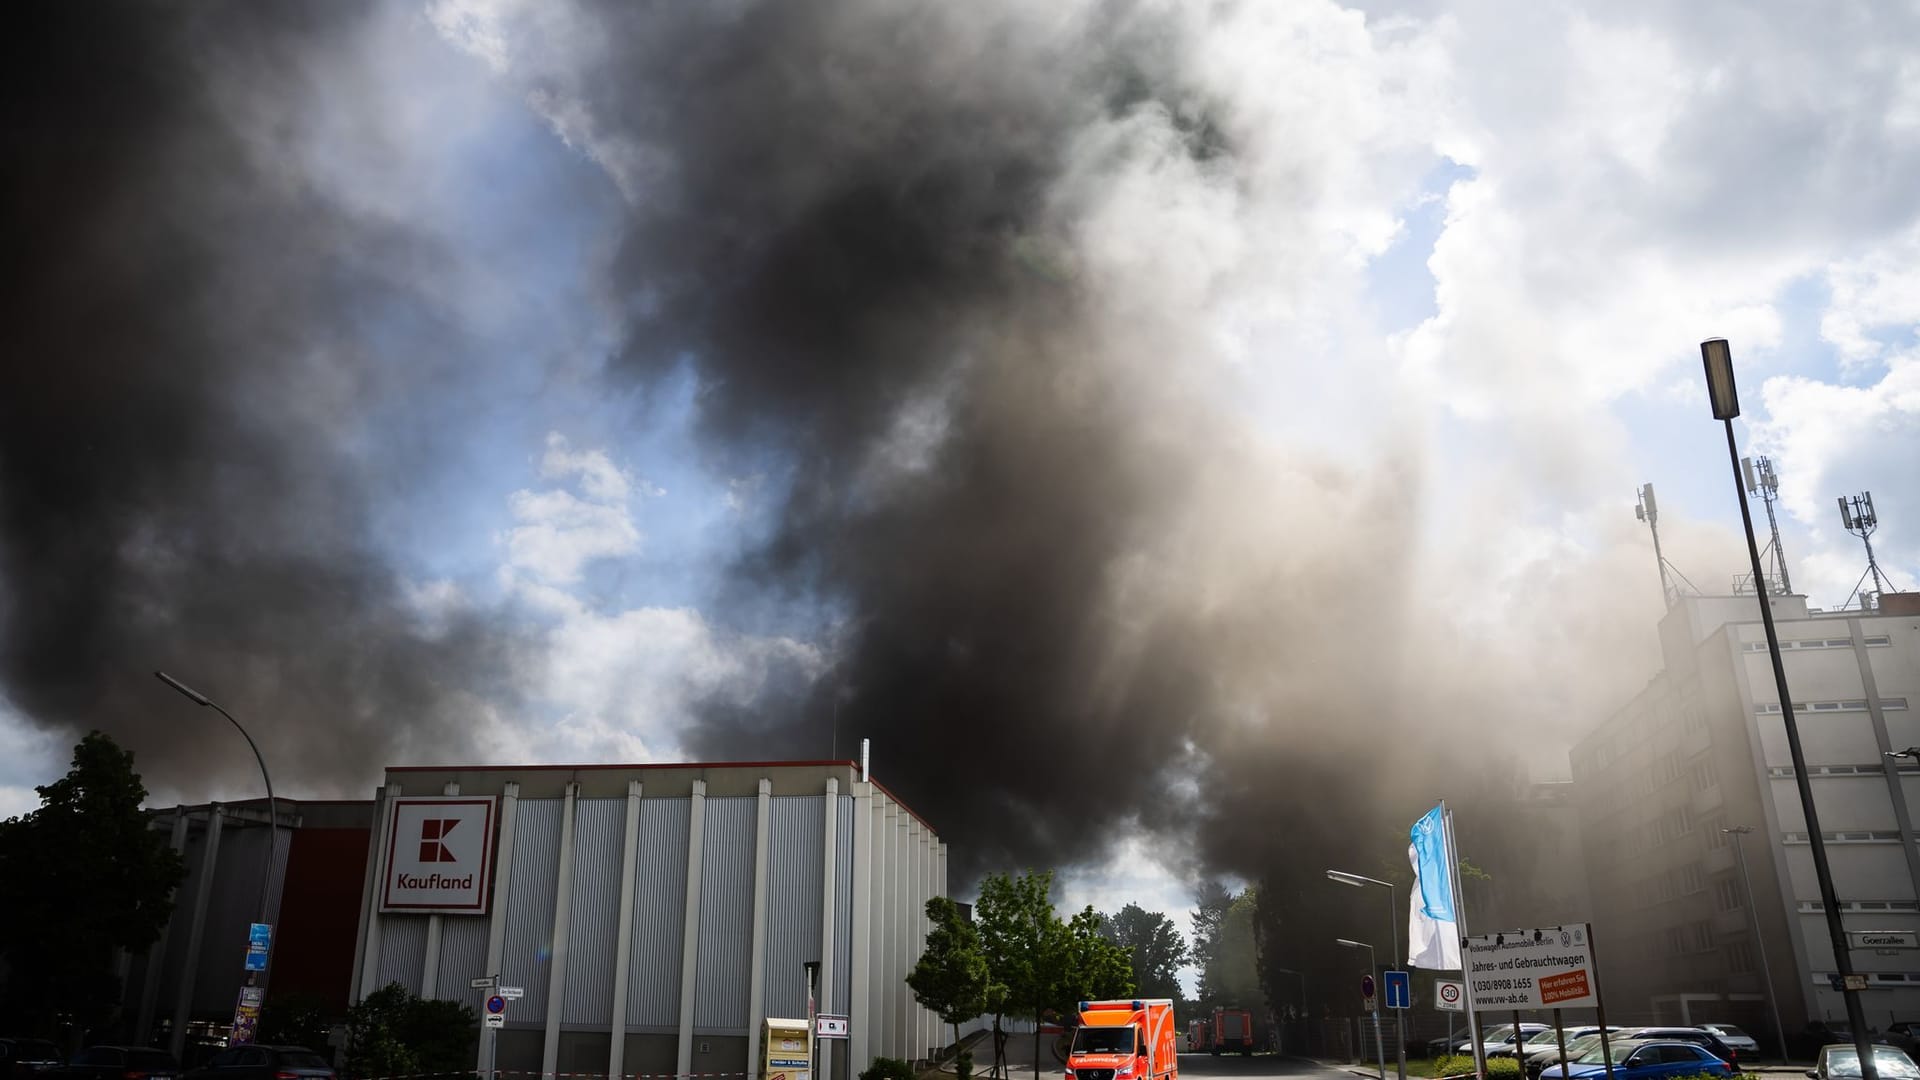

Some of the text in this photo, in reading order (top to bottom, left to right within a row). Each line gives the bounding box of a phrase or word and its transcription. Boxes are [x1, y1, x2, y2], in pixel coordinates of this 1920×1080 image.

[397, 873, 473, 889] Kaufland
[1469, 943, 1501, 953] Volkswagen
[1502, 939, 1534, 949] Automobile
[1862, 935, 1905, 945] Goerzallee
[1472, 954, 1585, 973] Jahres- und Gebrauchtwagen
[1477, 978, 1532, 991] 030/8908 1655
[1541, 974, 1585, 990] Hier erfahren Sie
[1445, 989, 1455, 998] 30
[1475, 993, 1529, 1005] www.vw-ab.de
[1543, 991, 1559, 1001] 100%
